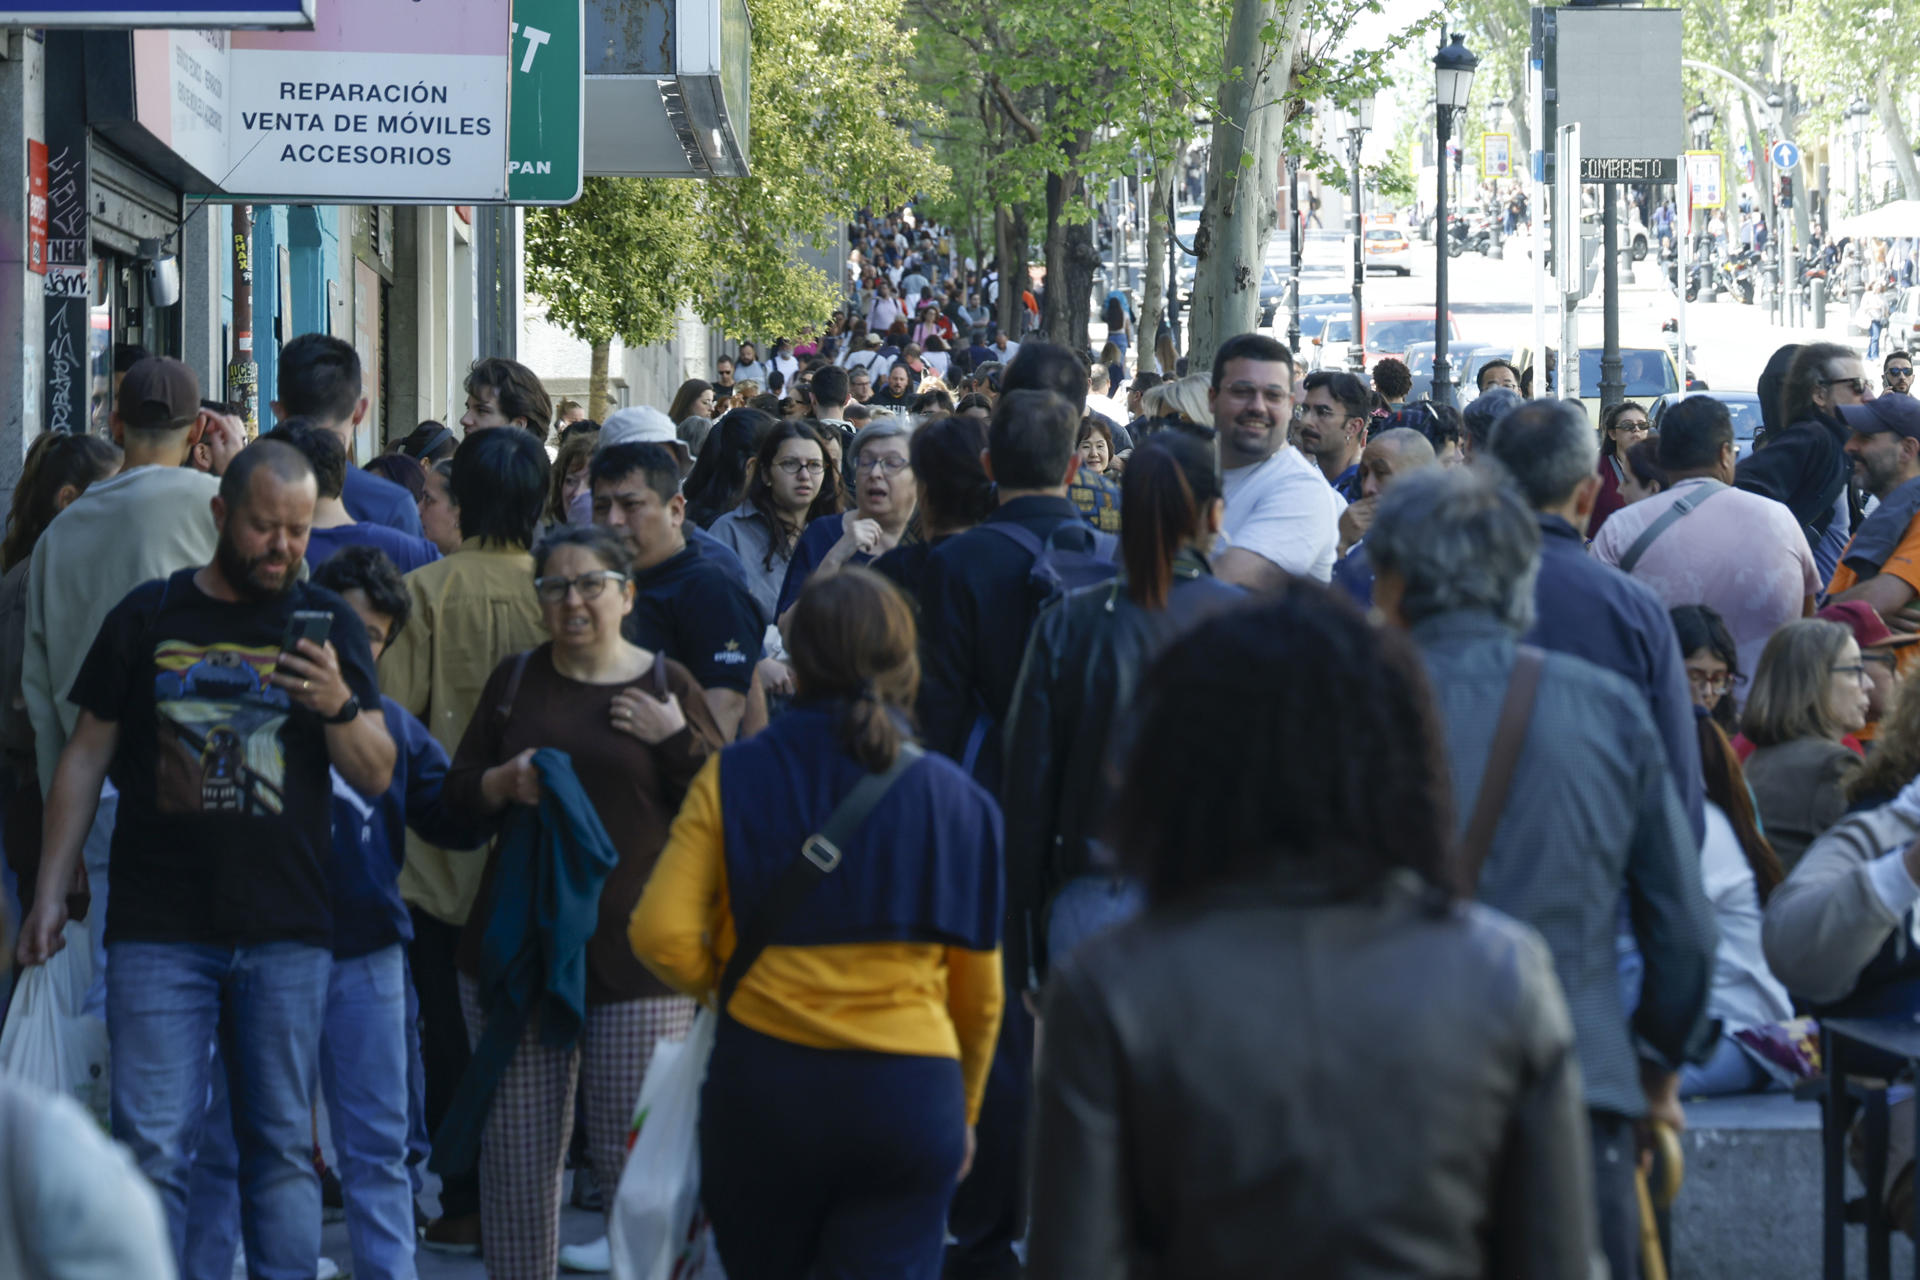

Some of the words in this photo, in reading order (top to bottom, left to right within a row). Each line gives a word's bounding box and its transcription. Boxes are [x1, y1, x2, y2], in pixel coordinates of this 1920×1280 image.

[511, 22, 551, 73] T
[280, 81, 447, 103] REPARACIÓN
[242, 112, 324, 131] VENTA
[335, 114, 368, 132] DE
[378, 111, 491, 136] MÓVILES
[280, 144, 451, 165] ACCESORIOS
[508, 161, 551, 174] PAN
